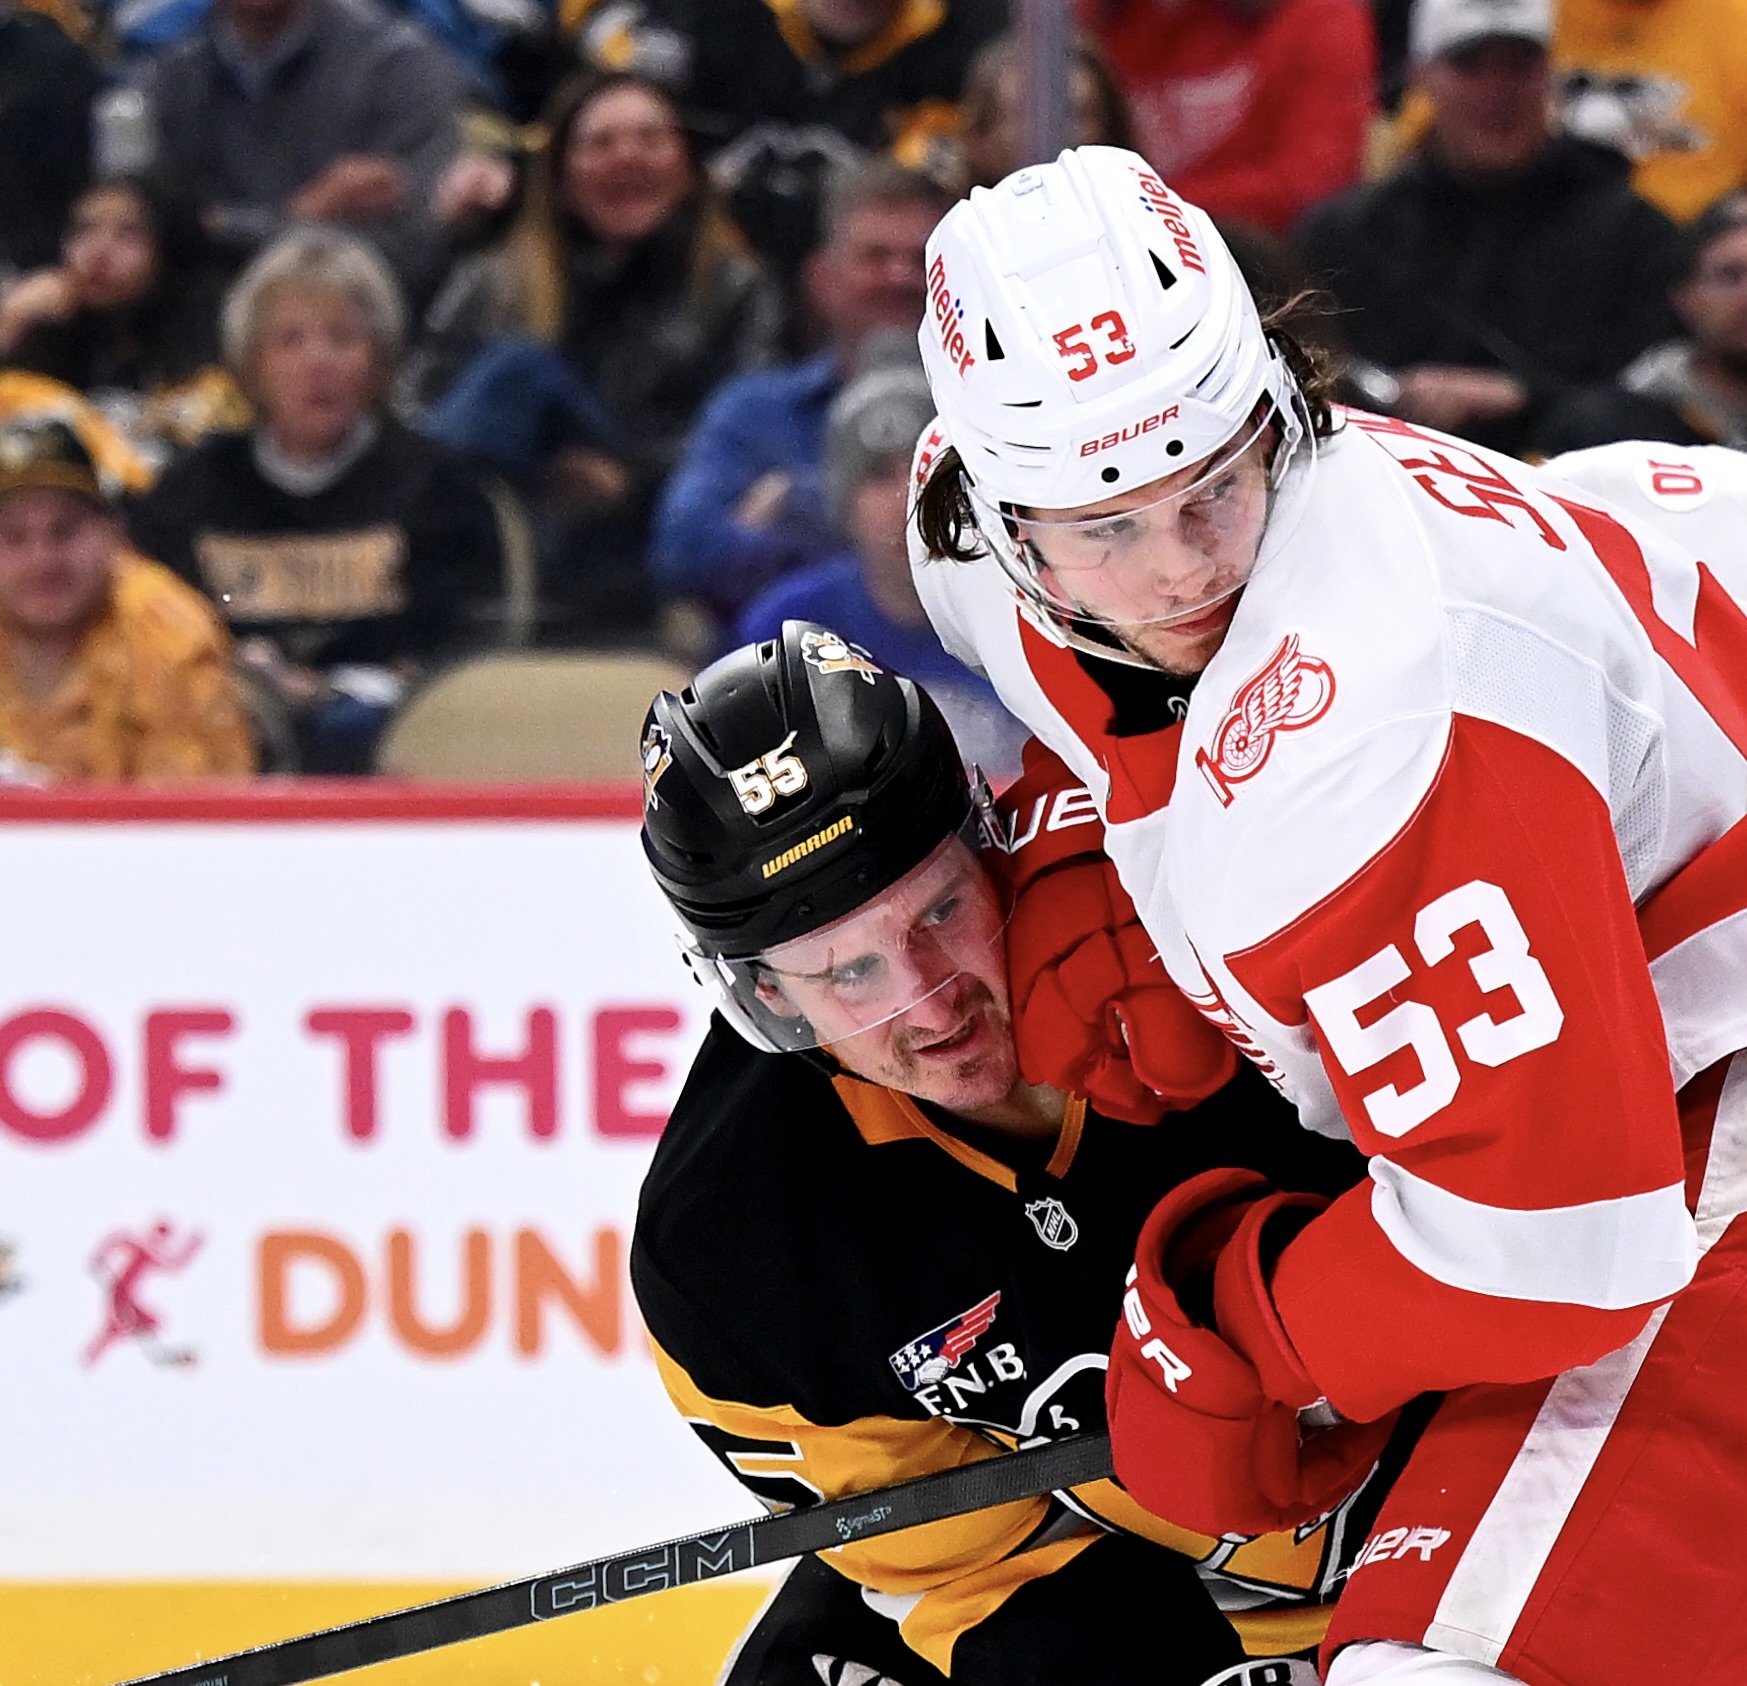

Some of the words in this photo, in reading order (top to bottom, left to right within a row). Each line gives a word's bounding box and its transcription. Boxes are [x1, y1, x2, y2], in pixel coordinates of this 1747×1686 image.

[1129, 166, 1207, 276] meijer
[926, 253, 976, 381] meijer
[1052, 309, 1137, 383] 53
[1079, 404, 1181, 459] BAUER
[727, 731, 809, 815] 55
[762, 814, 854, 879] WARRIOR
[1302, 878, 1565, 1139] 53
[0, 1009, 233, 1141] OF
[307, 1008, 682, 1139] THE
[257, 1230, 640, 1358] DUN
[529, 1524, 755, 1622] CCM
